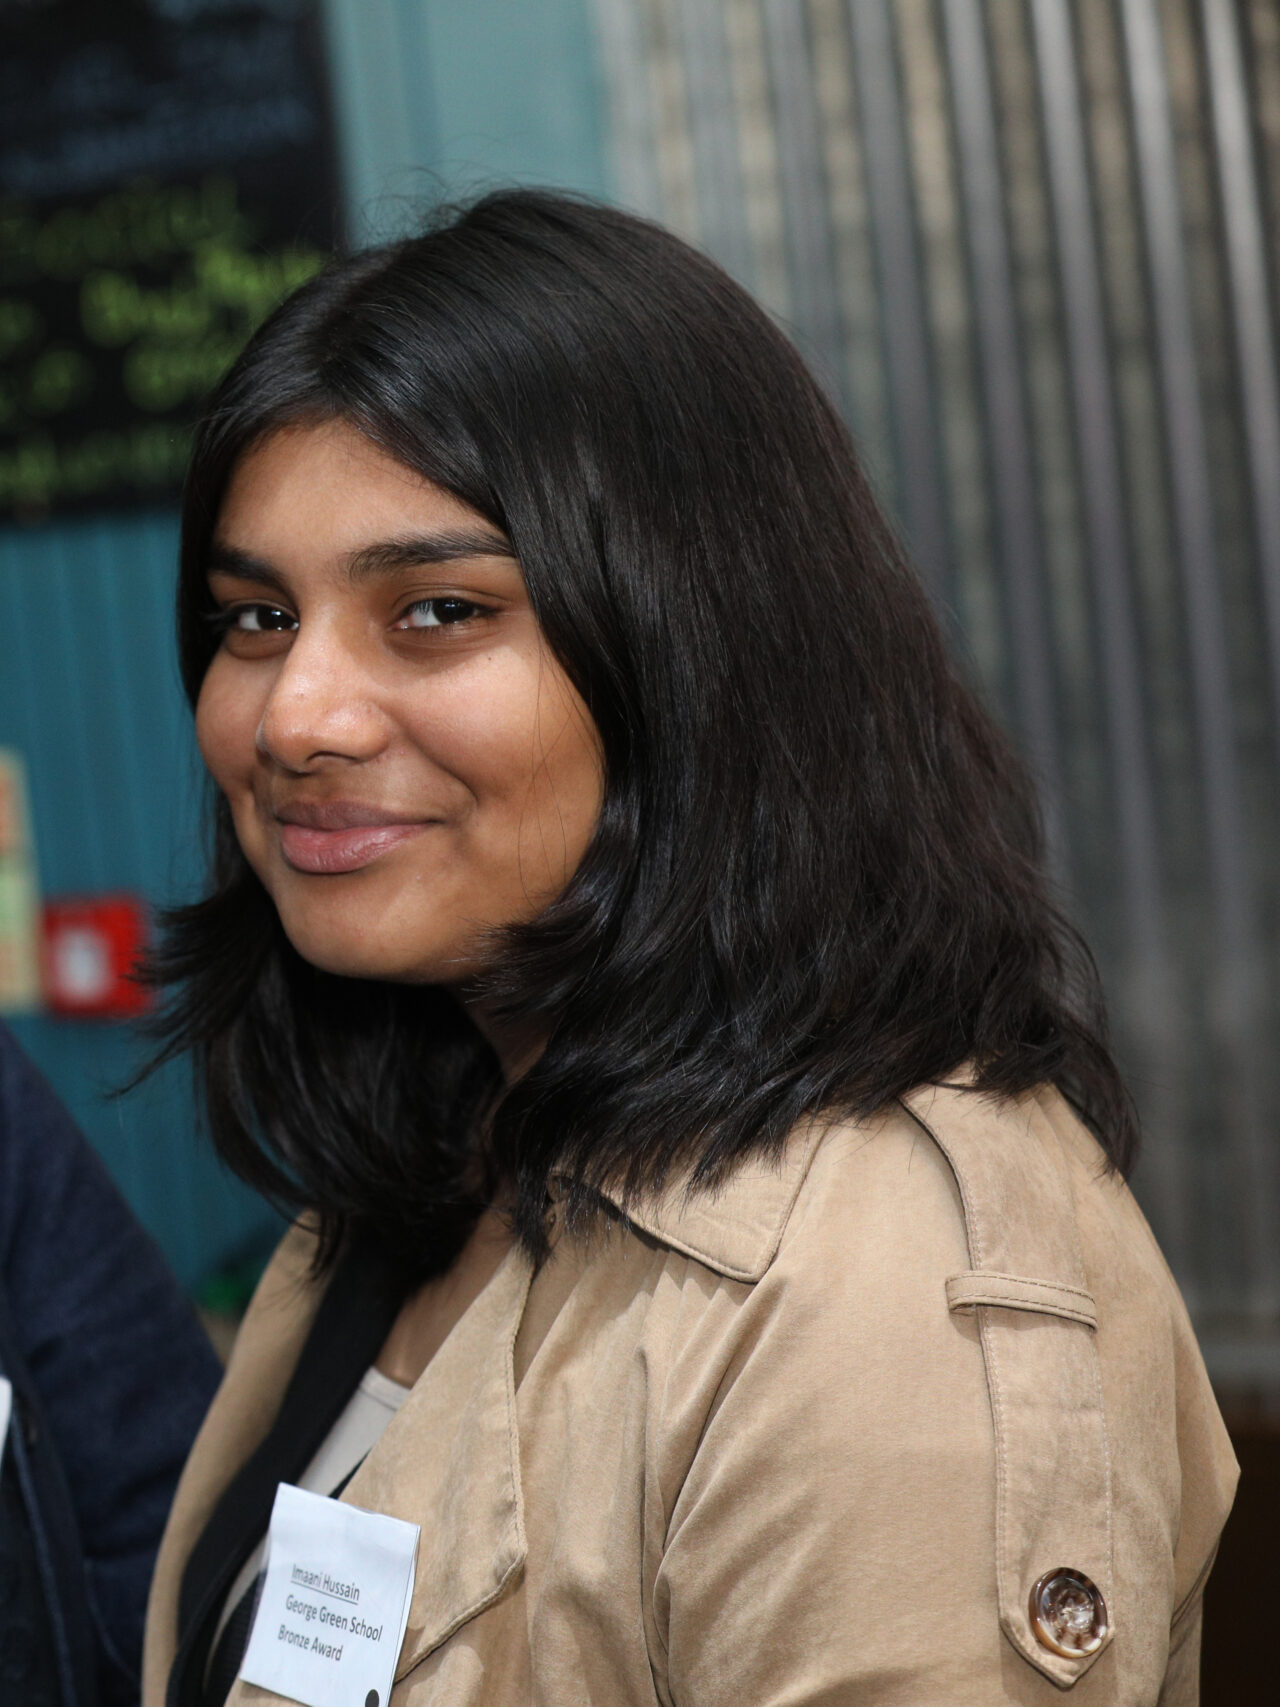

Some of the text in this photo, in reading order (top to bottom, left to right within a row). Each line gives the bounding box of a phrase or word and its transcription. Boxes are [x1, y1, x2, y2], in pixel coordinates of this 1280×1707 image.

[291, 1564, 360, 1601] Imaani Hussain
[286, 1594, 384, 1642] George Green School
[277, 1624, 344, 1661] Bronze Award
